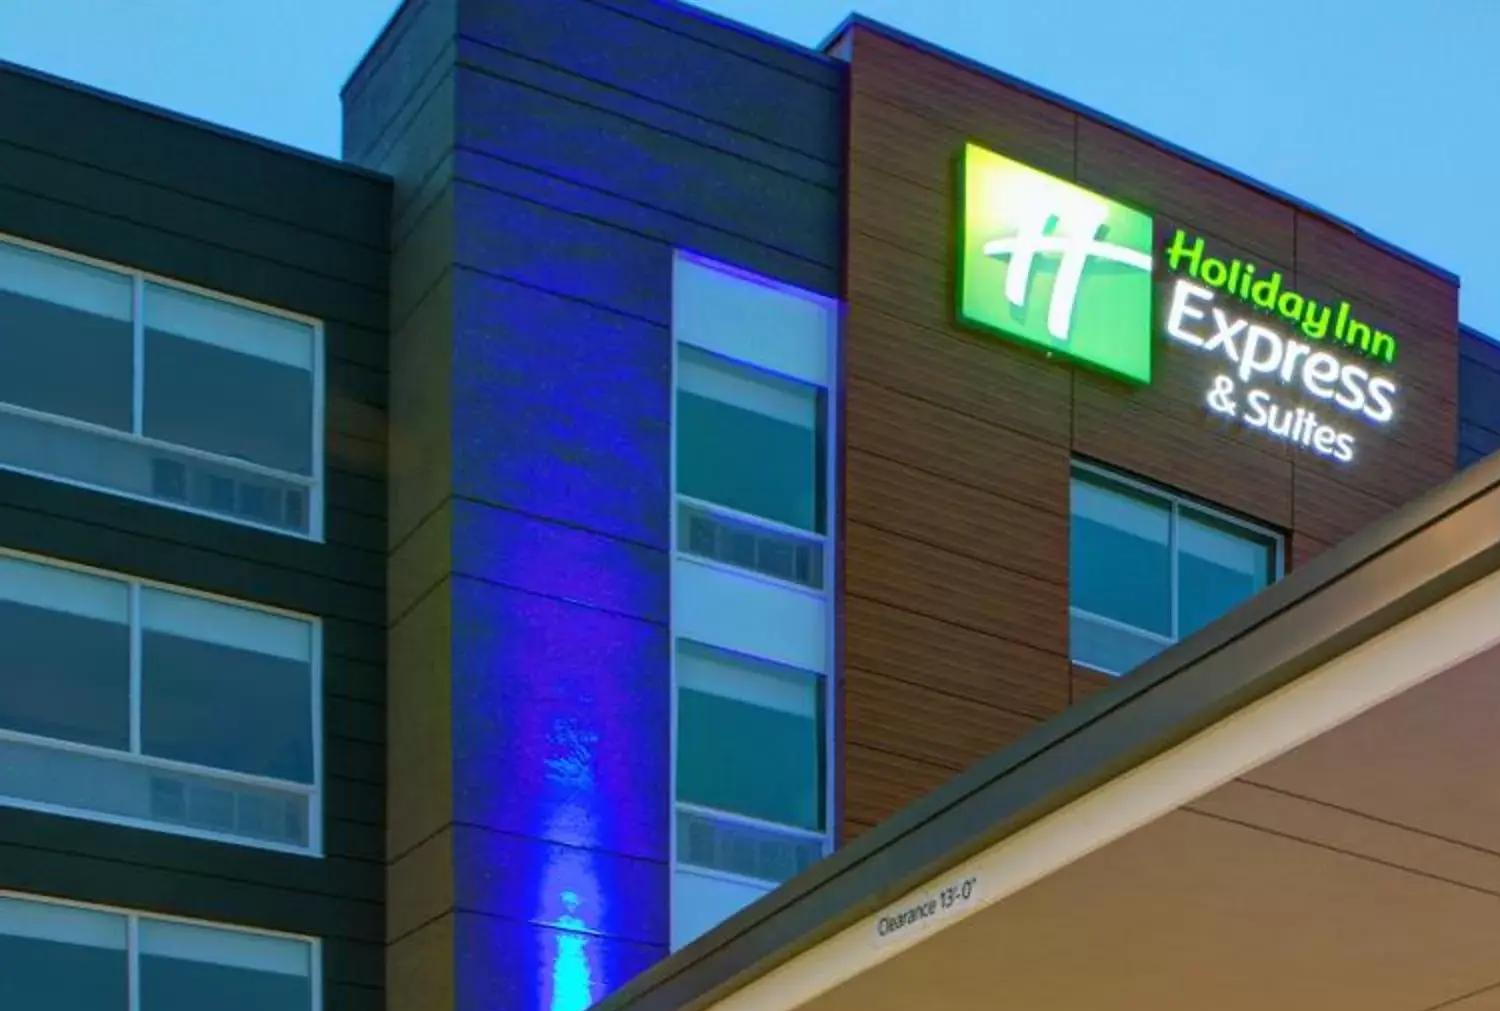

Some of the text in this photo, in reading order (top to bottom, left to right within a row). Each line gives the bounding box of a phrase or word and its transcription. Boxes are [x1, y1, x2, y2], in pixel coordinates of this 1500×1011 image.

[1166, 229, 1396, 363] Holiday Inn
[1167, 279, 1396, 422] Express
[1207, 375, 1355, 461] & Suites
[877, 900, 937, 937] Clearance
